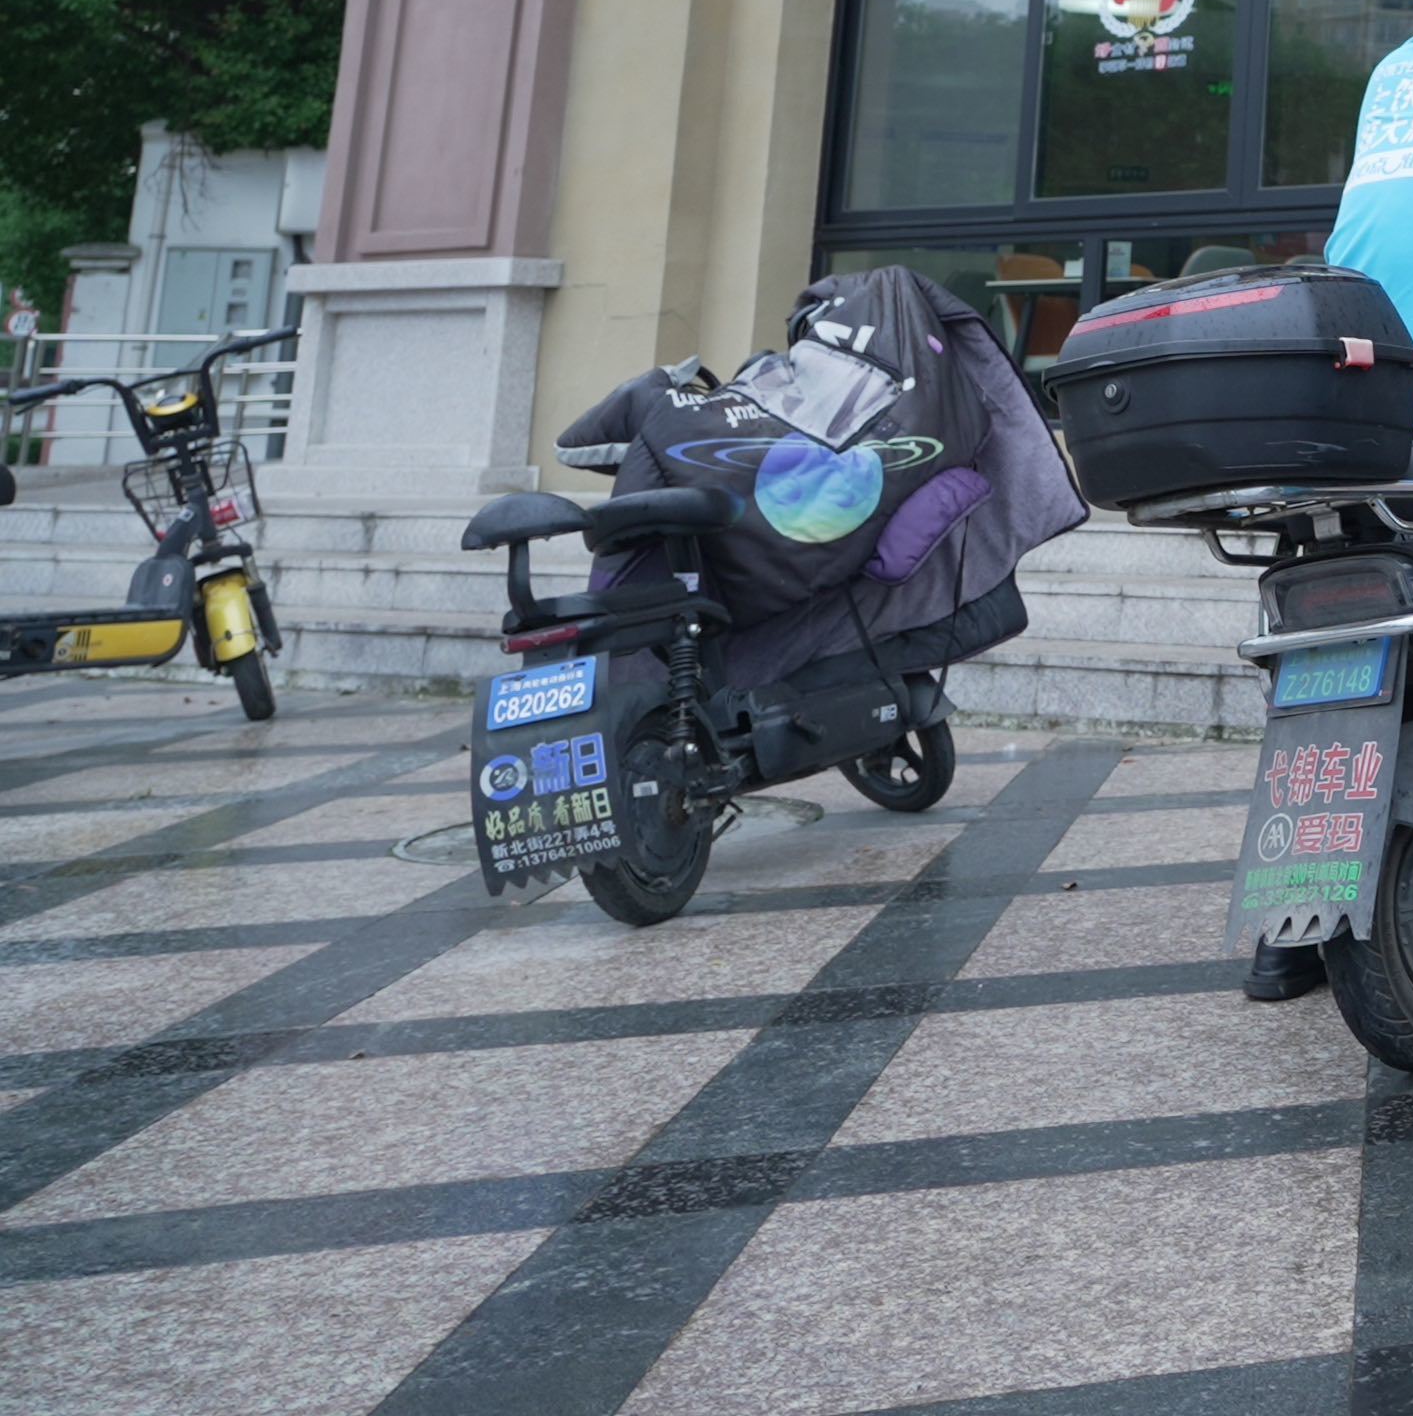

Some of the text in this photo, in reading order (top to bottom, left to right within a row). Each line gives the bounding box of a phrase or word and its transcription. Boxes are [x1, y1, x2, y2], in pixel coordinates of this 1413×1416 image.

[493, 683, 586, 724] C820262
[1282, 665, 1372, 701] Z276148
[530, 732, 607, 796] 新日
[485, 787, 612, 841] 好品质 看新日
[1292, 812, 1364, 854] 爱玛
